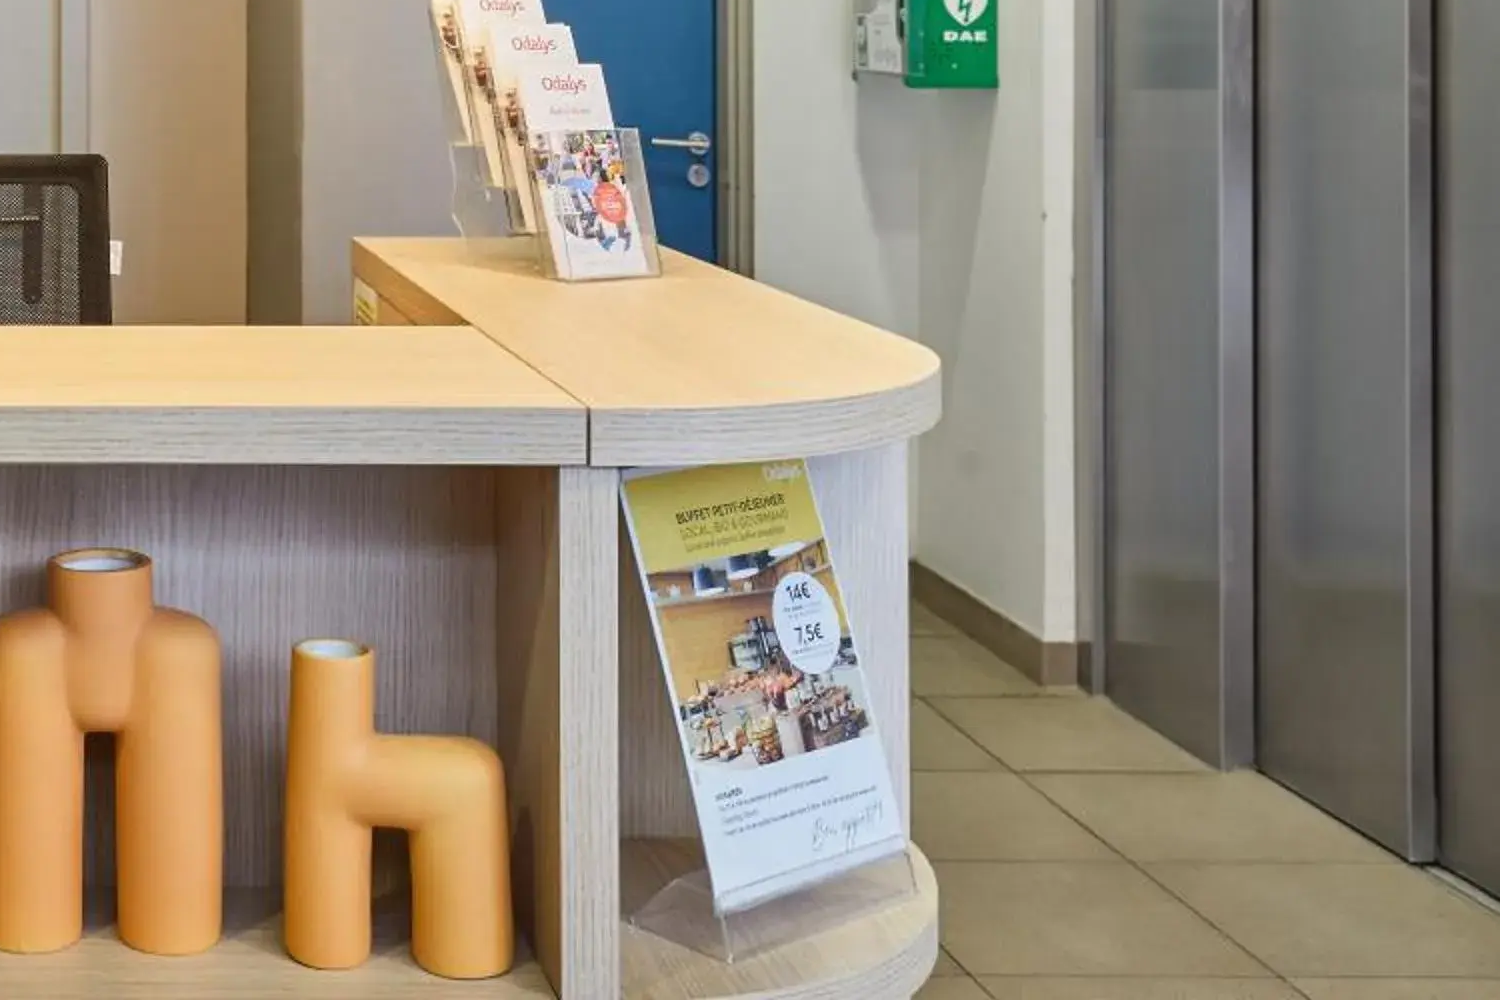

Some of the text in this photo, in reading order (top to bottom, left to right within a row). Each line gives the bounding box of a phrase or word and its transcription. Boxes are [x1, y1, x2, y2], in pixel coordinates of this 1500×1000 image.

[943, 30, 988, 42] DAE
[511, 36, 558, 55] Odalys
[541, 75, 587, 95] Odalys
[786, 582, 811, 600] 14€
